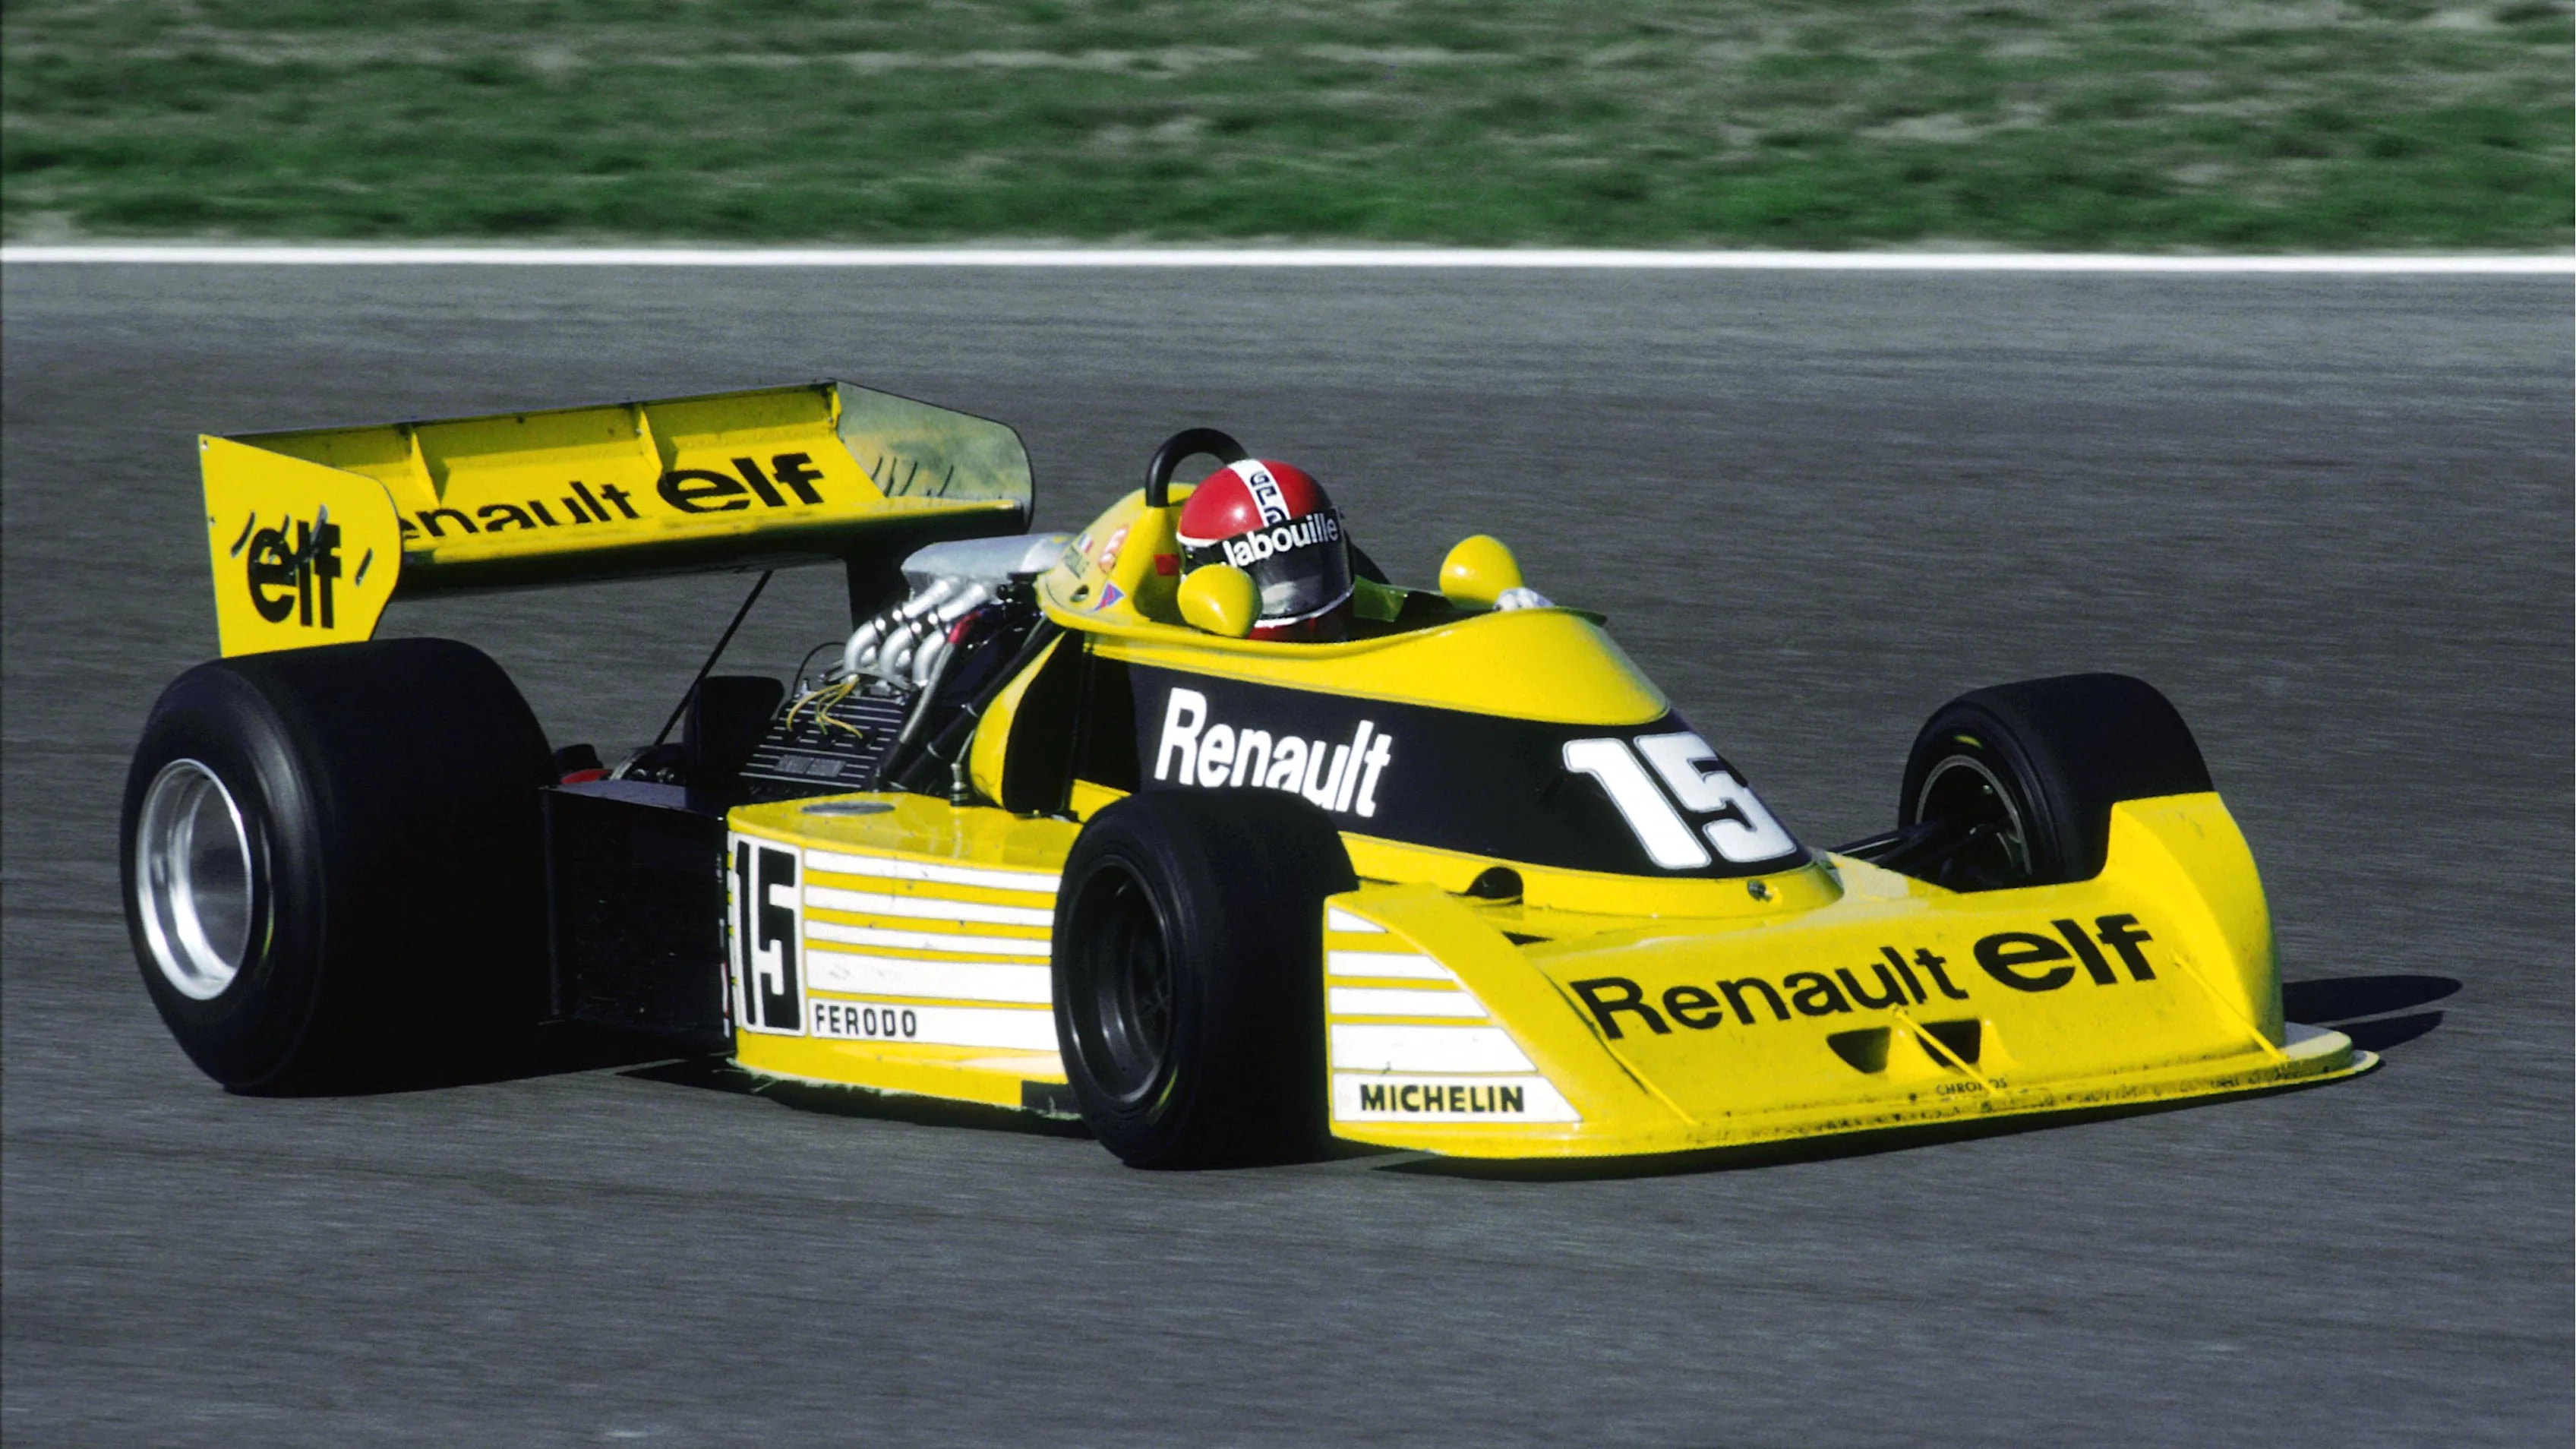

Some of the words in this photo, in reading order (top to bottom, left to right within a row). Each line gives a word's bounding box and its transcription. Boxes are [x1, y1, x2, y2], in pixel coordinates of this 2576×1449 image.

[657, 452, 824, 513] elf
[248, 519, 341, 629] elf
[1154, 687, 1392, 818] Renault
[1563, 731, 1798, 870] 15
[735, 839, 800, 1031] 15
[1568, 945, 1969, 1040] Renault
[1974, 914, 2155, 993] elf
[815, 1003, 917, 1037] FERODO
[1359, 1084, 1524, 1113] MICHELIN
